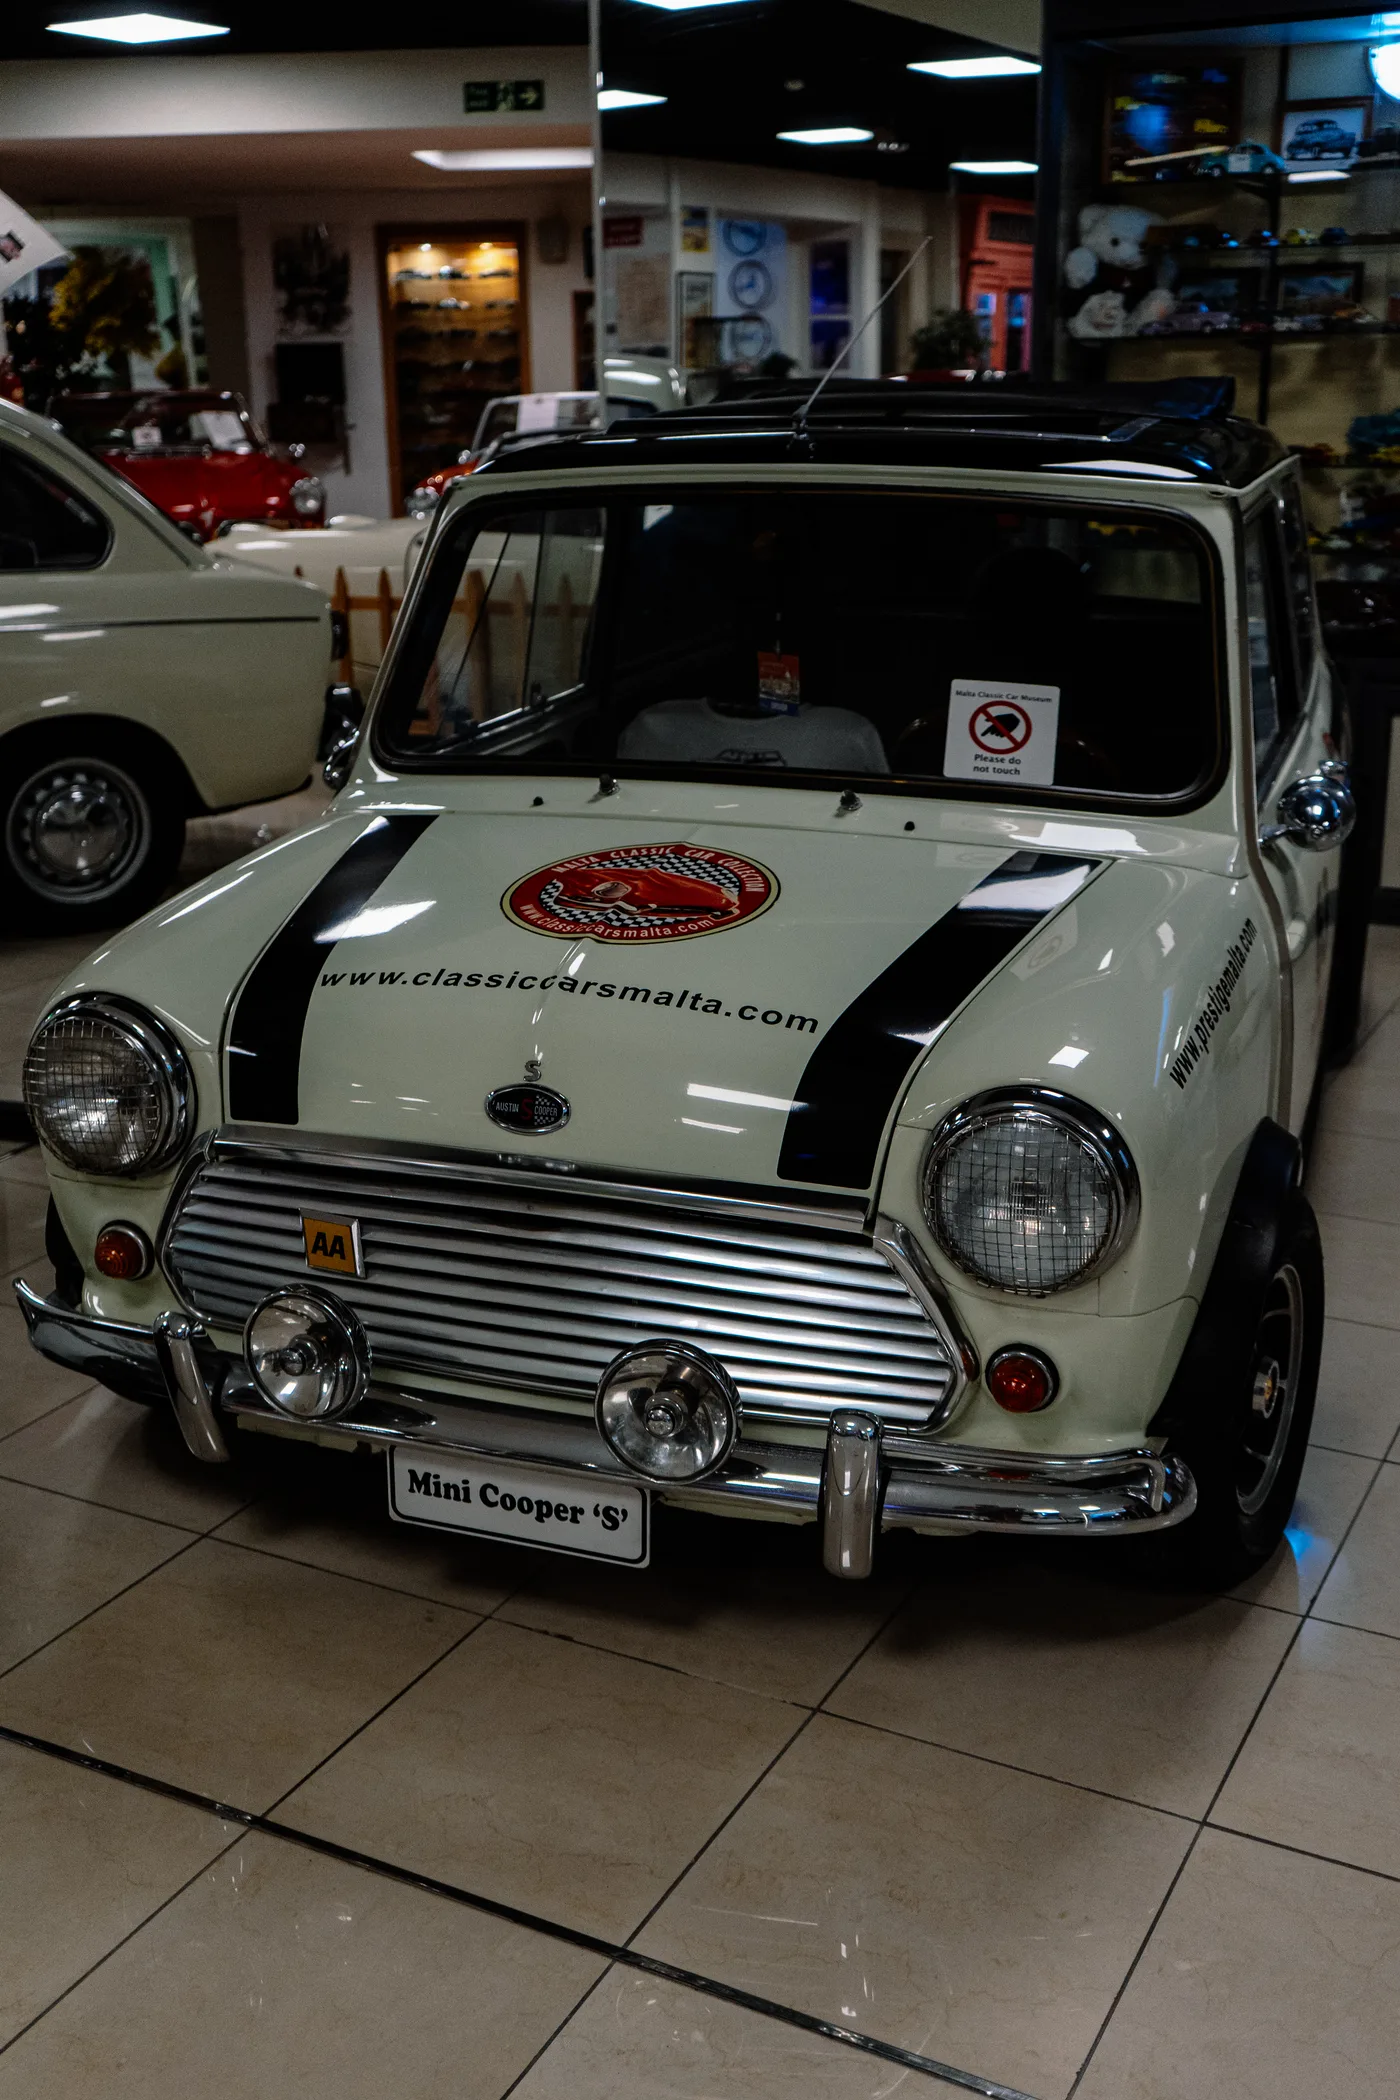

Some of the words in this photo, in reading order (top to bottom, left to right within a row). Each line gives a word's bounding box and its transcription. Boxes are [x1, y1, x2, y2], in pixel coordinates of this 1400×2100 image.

[955, 690, 976, 698] Malta
[978, 691, 1004, 700] Classic
[1021, 695, 1052, 703] Museum
[973, 764, 989, 773] not
[993, 766, 1021, 775] touch
[974, 753, 1005, 764] Please
[1008, 757, 1021, 765] do
[551, 855, 600, 874] MALTA
[610, 846, 676, 859] CLASSIC
[684, 849, 715, 860] CAR
[717, 857, 765, 893] COLLECTION
[519, 903, 715, 939] www.classiccarsmalta.com
[320, 968, 819, 1034] www.classiccarsmalta.com
[1169, 917, 1258, 1090] www.prestigemalta.com
[495, 1102, 519, 1113] AUSTIN
[534, 1105, 558, 1117] COOPER
[311, 1231, 346, 1260] AA
[407, 1469, 472, 1504] Mini
[479, 1483, 585, 1524] Cooper
